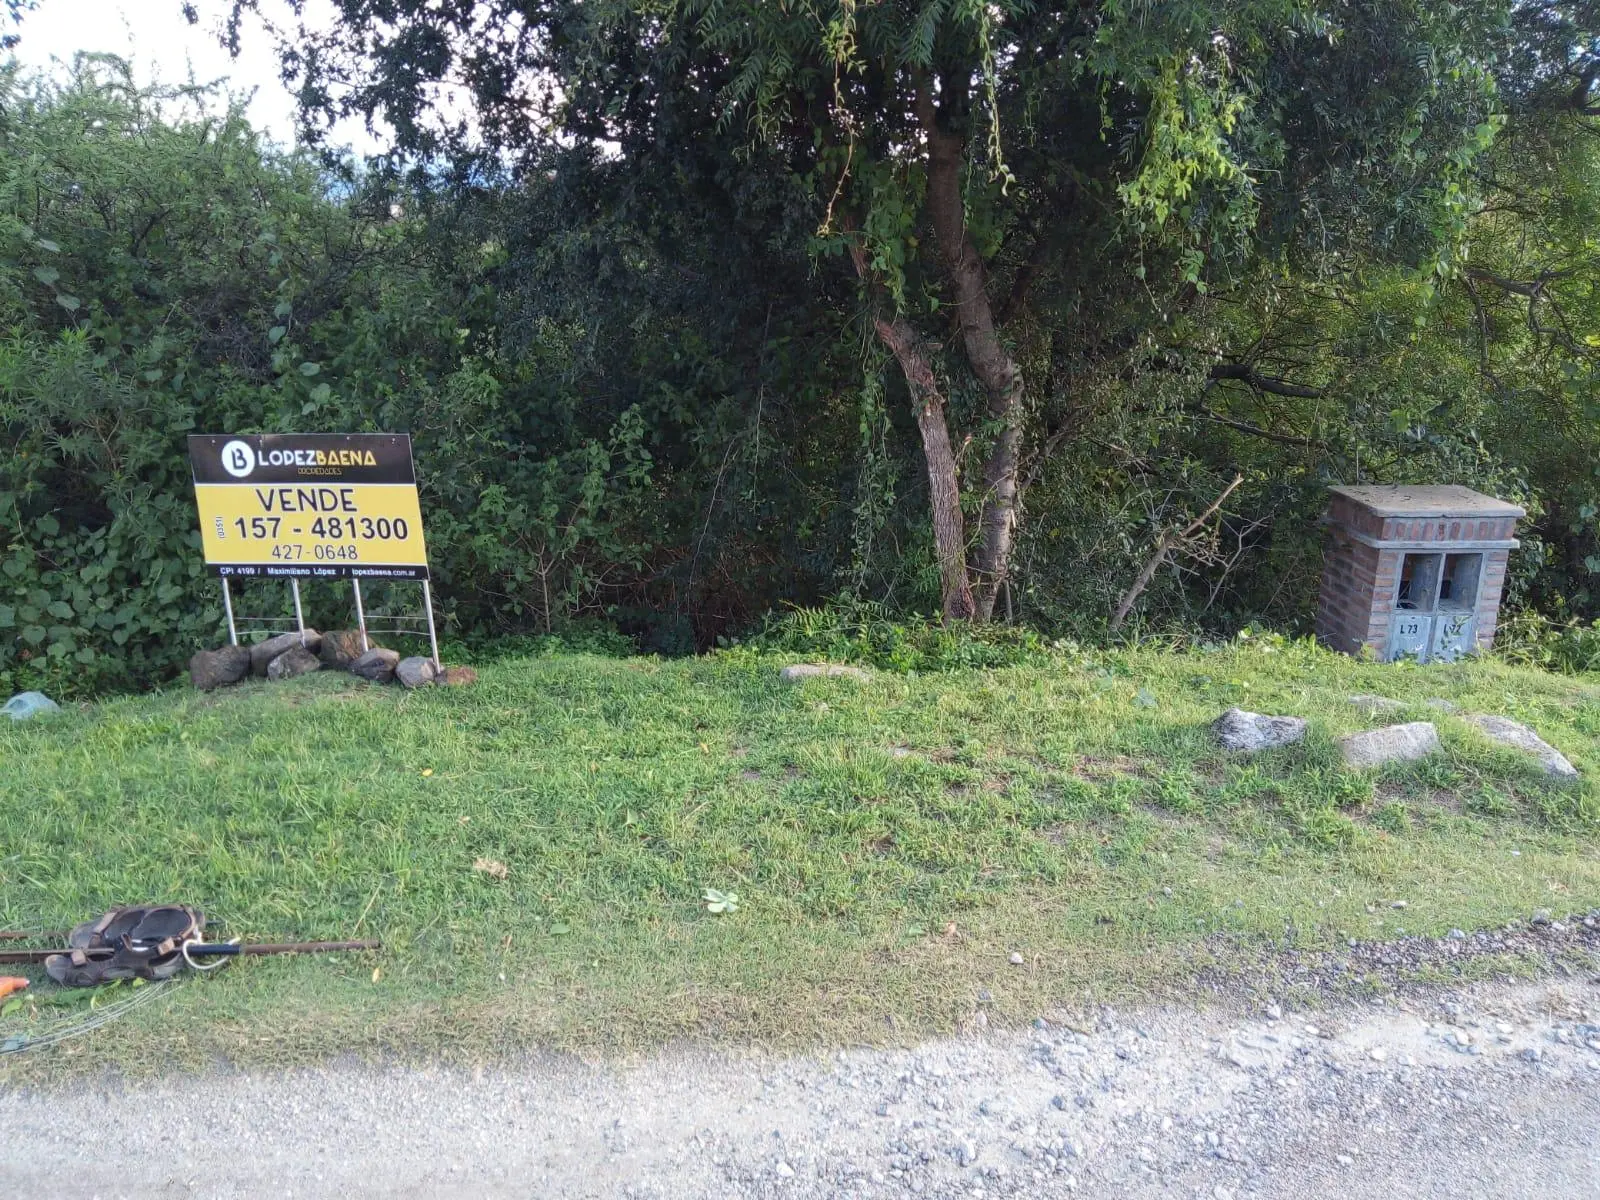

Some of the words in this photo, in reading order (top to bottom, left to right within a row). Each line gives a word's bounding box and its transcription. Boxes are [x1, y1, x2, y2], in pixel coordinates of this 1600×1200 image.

[256, 488, 358, 512] VENDE
[235, 517, 281, 539] 157
[311, 517, 408, 540] 481300
[272, 544, 358, 560] 427-0648
[220, 567, 234, 575] CPI
[267, 567, 310, 576] Maximiliano
[1407, 624, 1418, 634] 73
